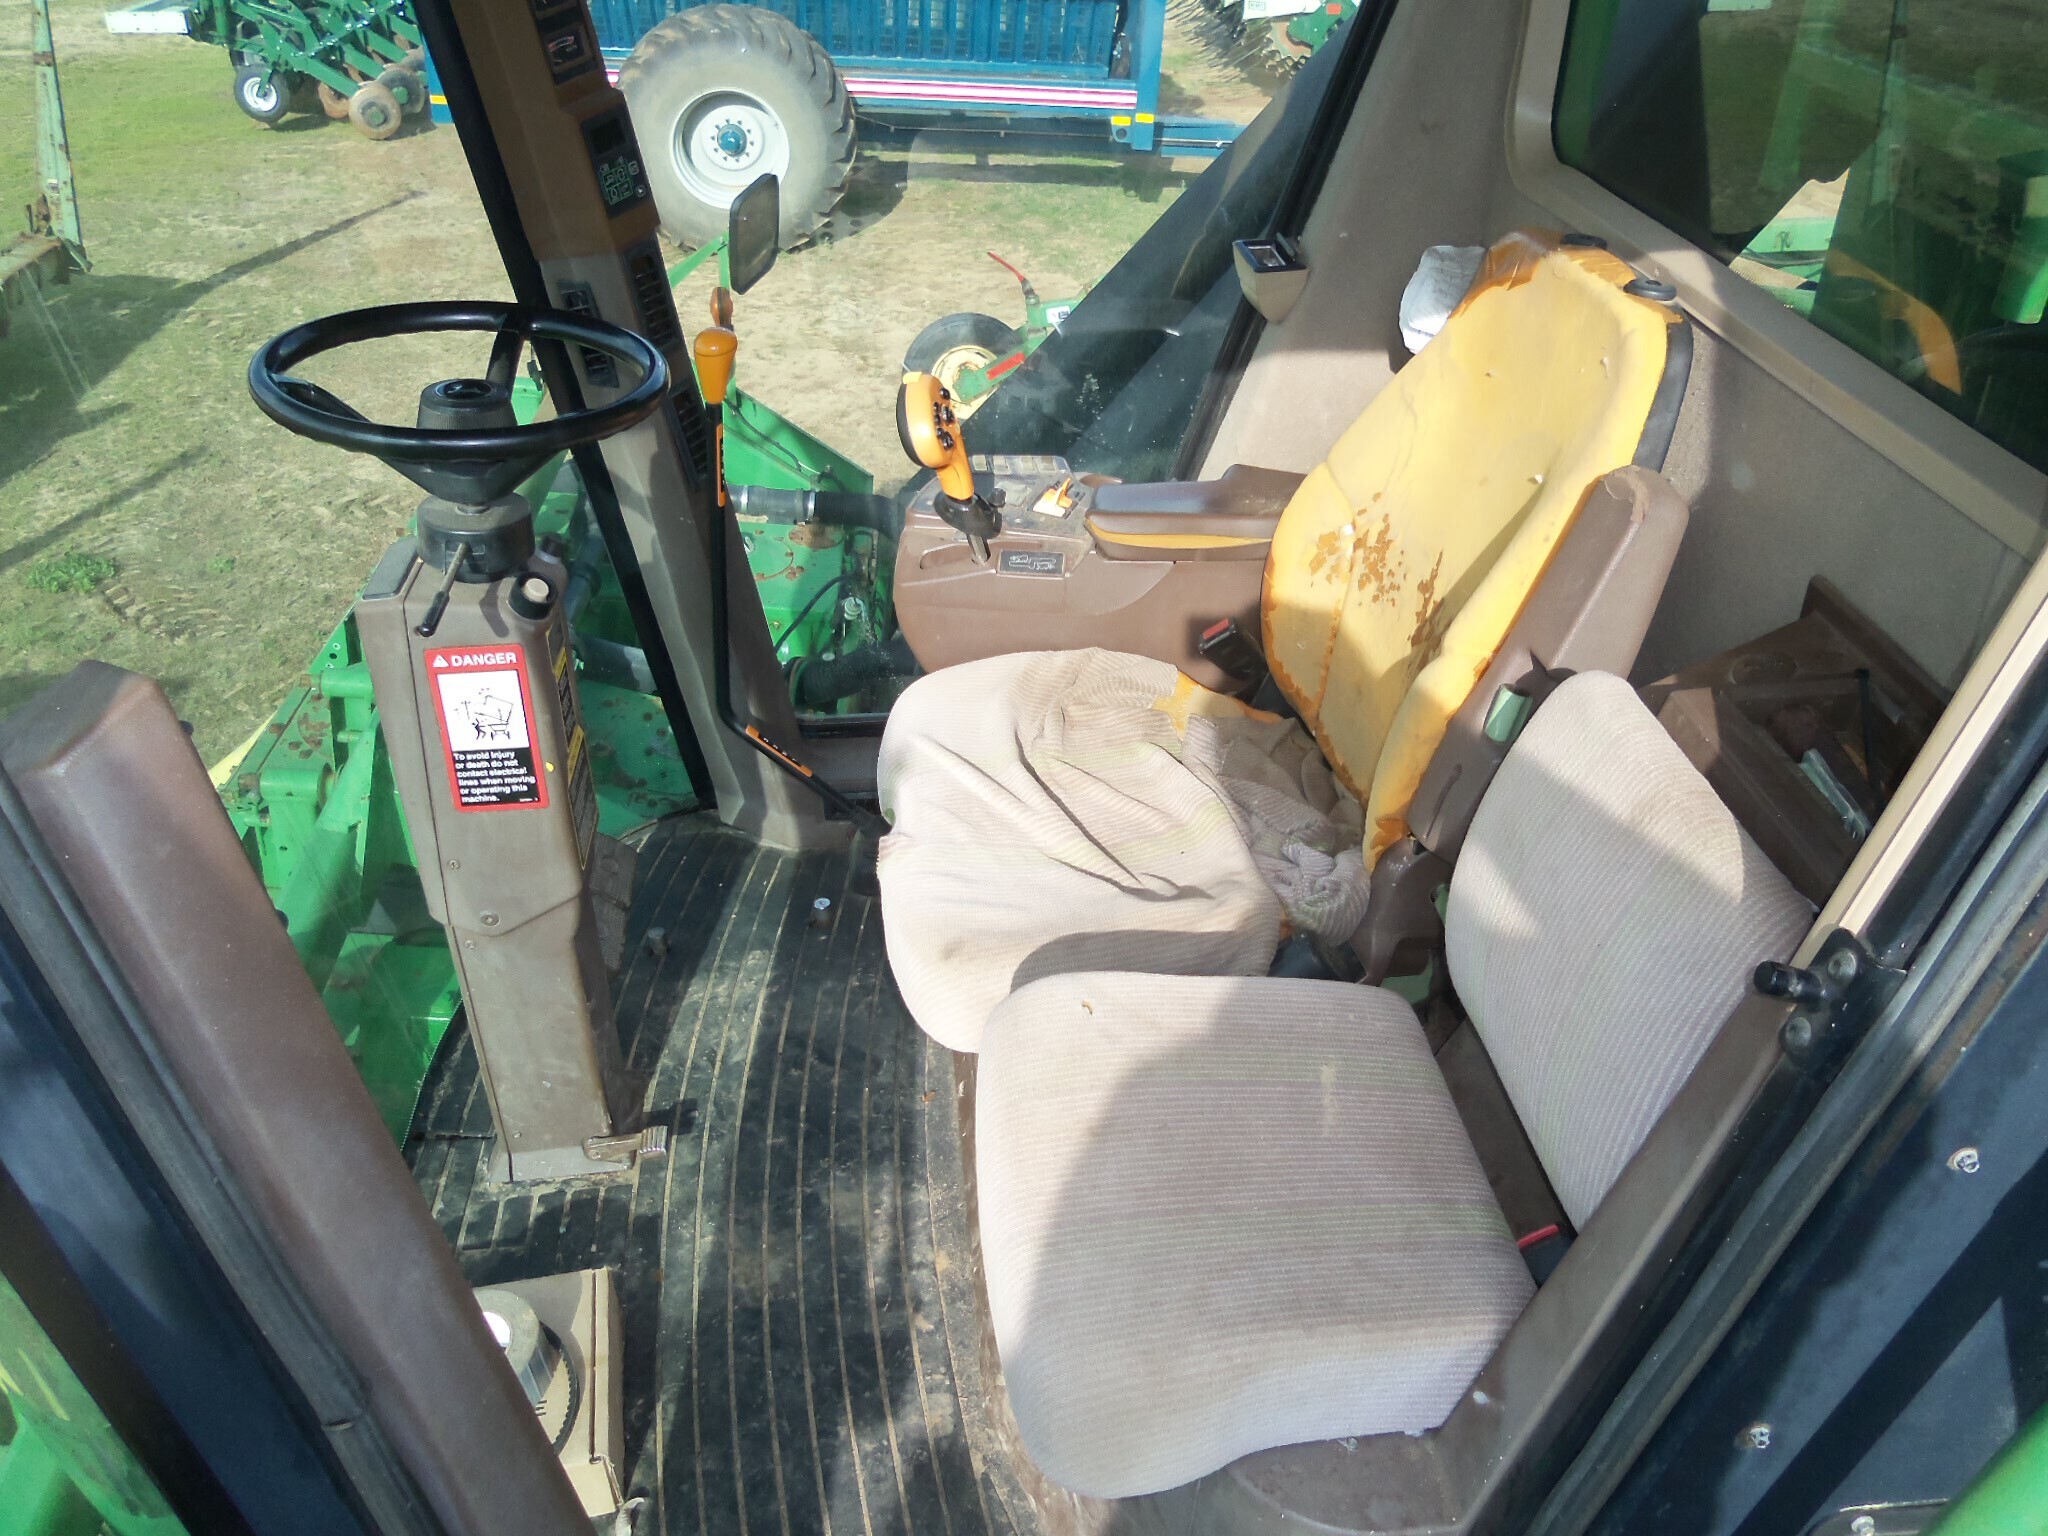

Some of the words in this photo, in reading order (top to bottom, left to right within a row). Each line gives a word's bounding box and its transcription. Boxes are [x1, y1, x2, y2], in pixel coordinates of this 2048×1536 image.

[451, 652, 517, 667] DANGER
[466, 752, 490, 760] avoid
[490, 751, 515, 760] injury
[466, 761, 490, 769] death
[503, 759, 519, 767] not
[489, 767, 527, 776] electrical
[480, 777, 503, 785] when
[504, 776, 536, 784] moving
[470, 786, 511, 795] operating
[511, 784, 528, 792] this
